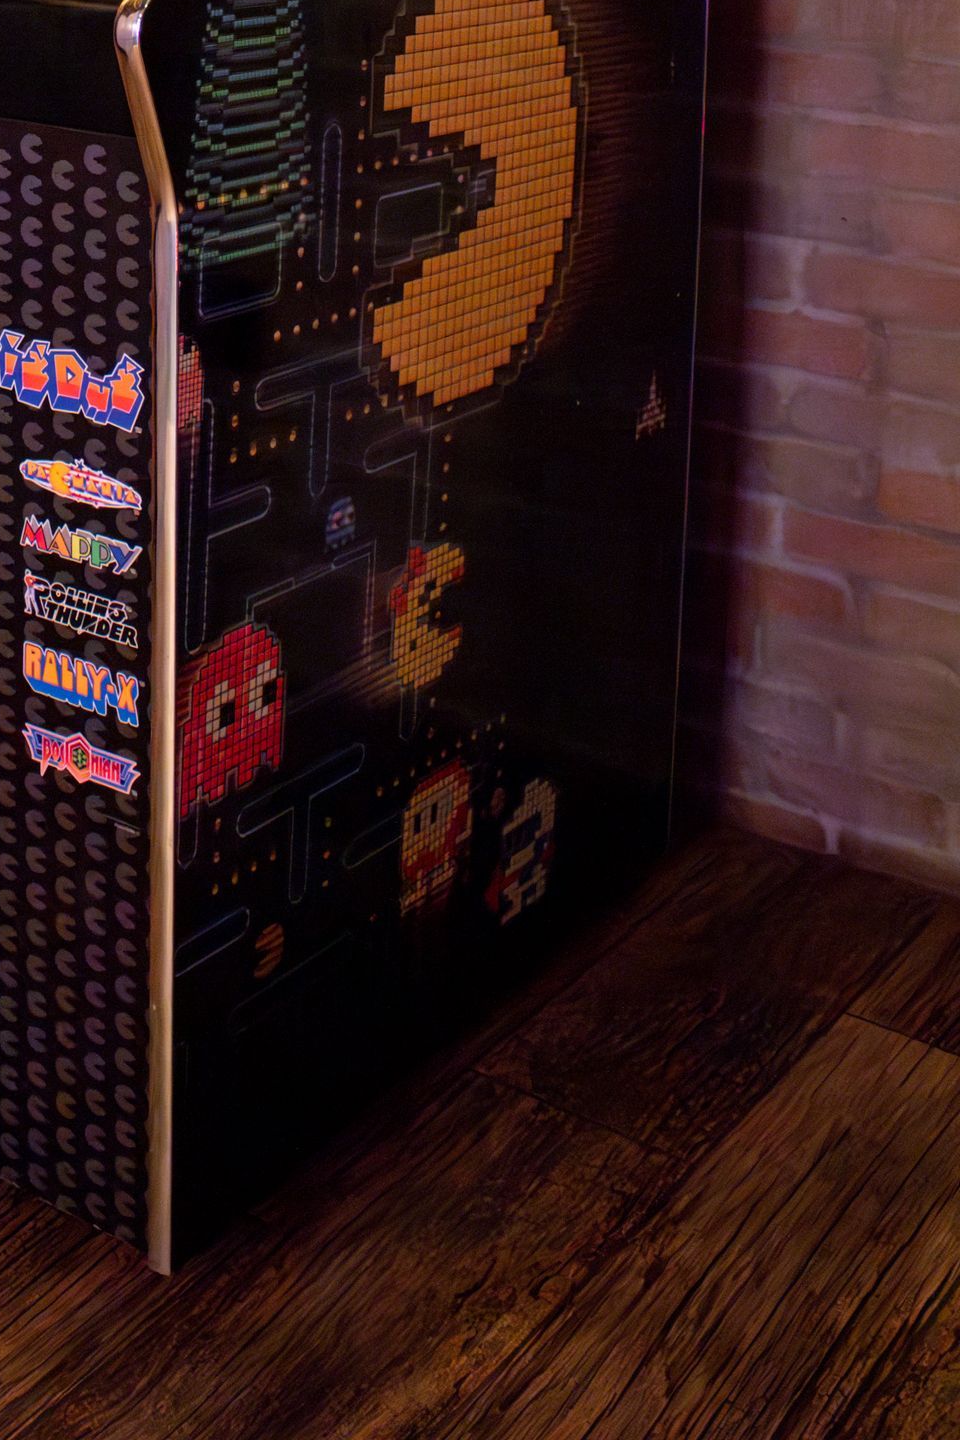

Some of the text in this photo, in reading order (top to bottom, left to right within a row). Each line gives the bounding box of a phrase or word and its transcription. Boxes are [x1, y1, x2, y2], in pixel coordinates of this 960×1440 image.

[20, 514, 143, 575] MAPPY
[31, 575, 129, 622] ROLLING
[44, 600, 138, 649] THUNDER
[23, 640, 139, 728] RALLY-X
